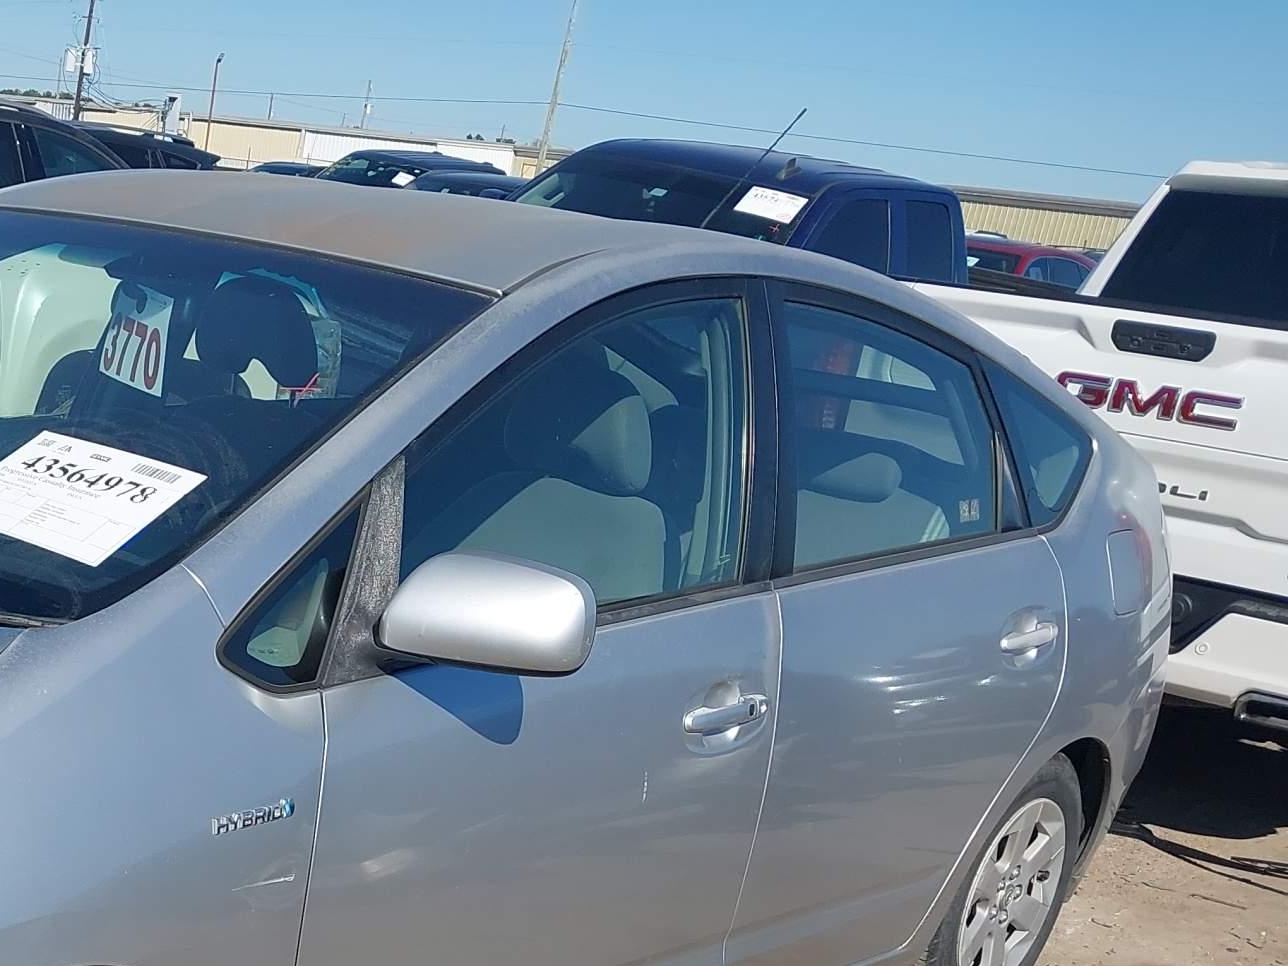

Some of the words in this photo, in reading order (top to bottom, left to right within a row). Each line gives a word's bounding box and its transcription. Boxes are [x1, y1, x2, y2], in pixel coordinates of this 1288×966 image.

[103, 312, 161, 390] 3770
[1056, 371, 1245, 431] GMC
[21, 456, 158, 504] 43564978
[211, 799, 288, 836] HYBRID
